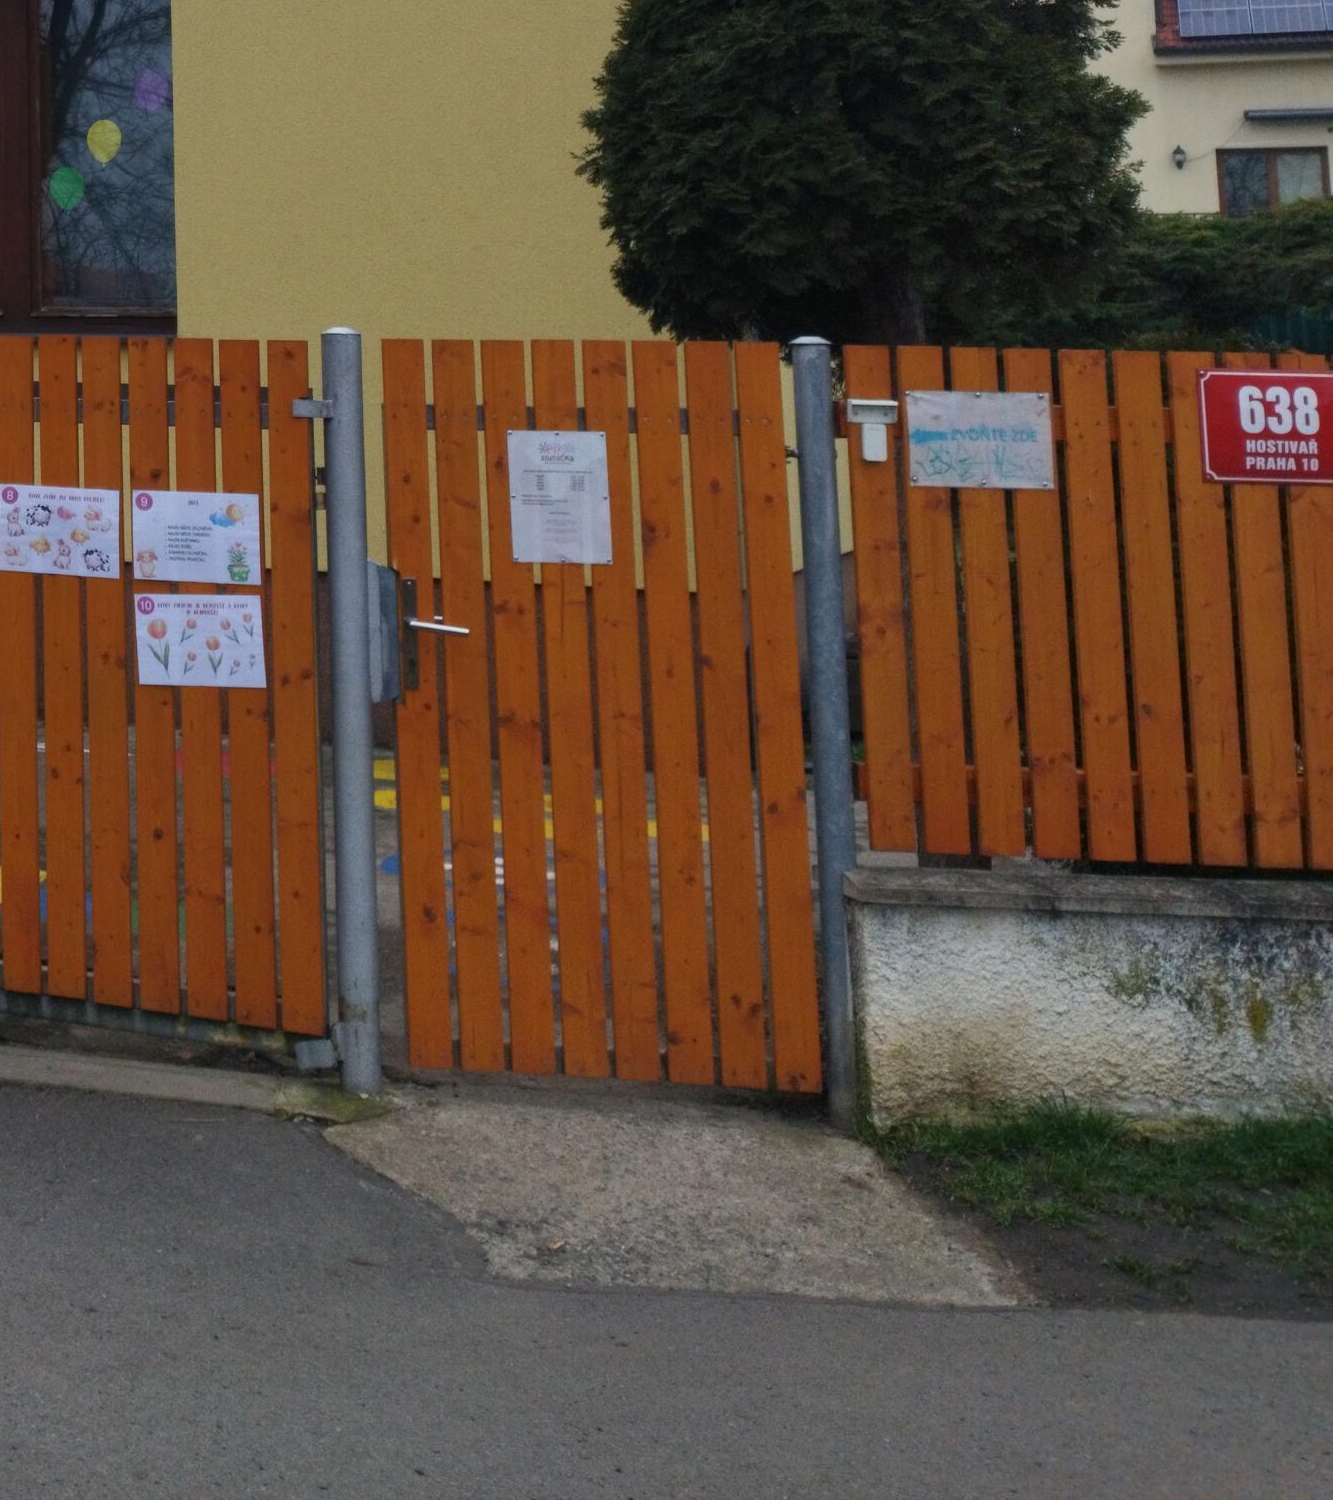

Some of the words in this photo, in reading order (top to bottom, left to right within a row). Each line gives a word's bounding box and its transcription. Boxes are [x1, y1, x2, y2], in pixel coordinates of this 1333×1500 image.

[1238, 385, 1320, 436] 638
[1011, 427, 1038, 443] ZDE
[1246, 438, 1318, 454] HOSTIVAŘ
[1246, 456, 1297, 471] PRAHA
[1301, 458, 1319, 472] 10
[6, 491, 14, 501] 8
[140, 497, 148, 507] 9
[140, 600, 152, 611] 10
